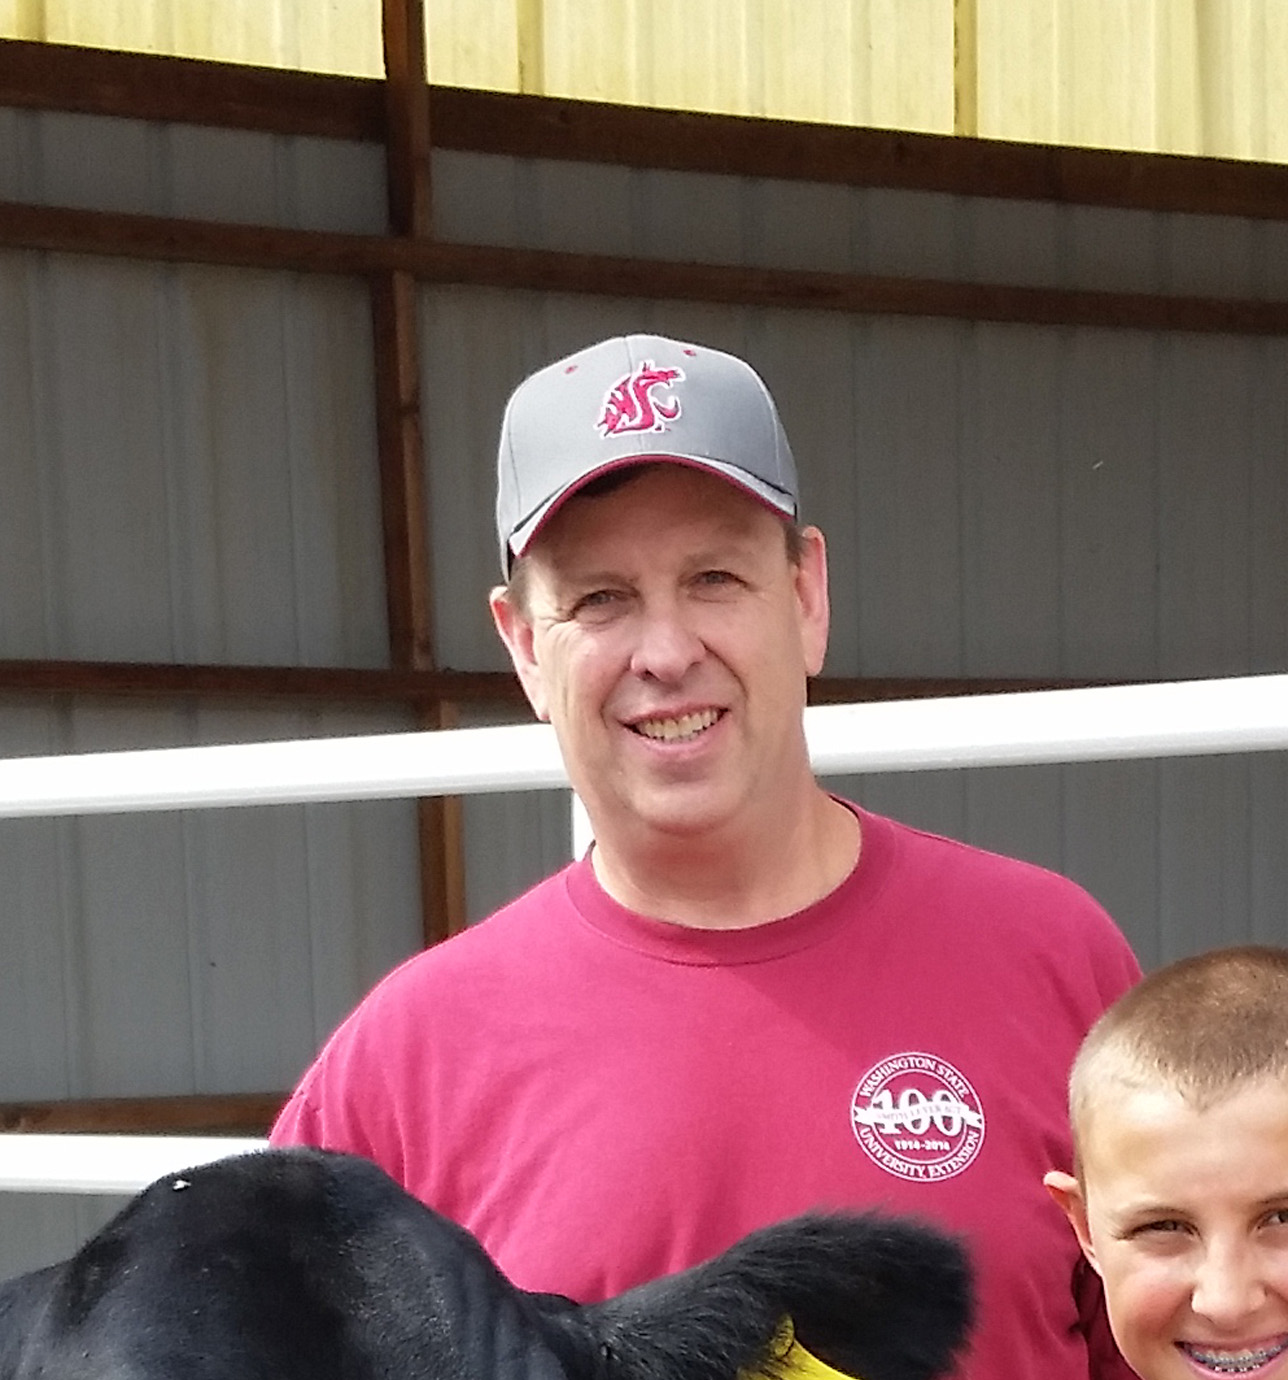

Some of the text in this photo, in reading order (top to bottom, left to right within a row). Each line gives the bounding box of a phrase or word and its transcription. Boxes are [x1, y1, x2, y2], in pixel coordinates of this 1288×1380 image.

[859, 1056, 970, 1098] WASHINGTON STATE
[871, 1088, 962, 1137] 100
[859, 1127, 980, 1178] UNIVERSITY EXTENSION
[894, 1139, 951, 1151] 1914-2014
